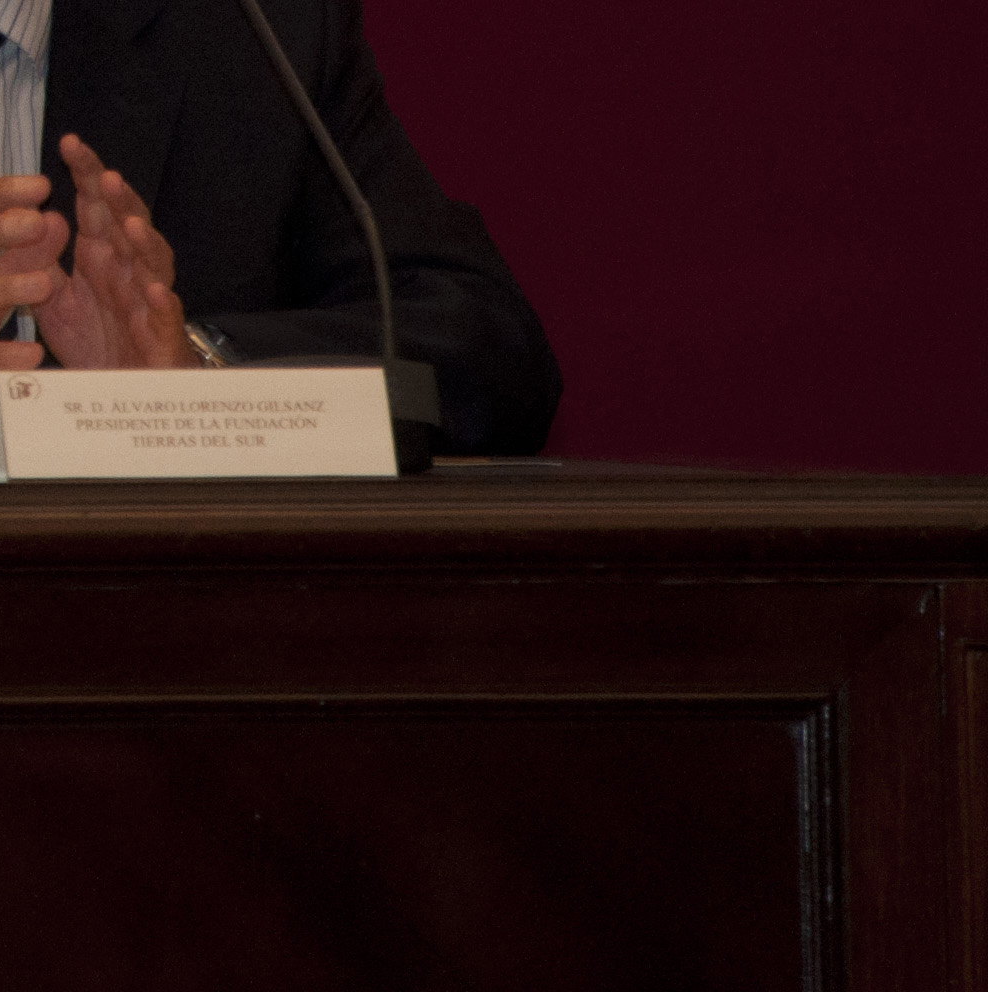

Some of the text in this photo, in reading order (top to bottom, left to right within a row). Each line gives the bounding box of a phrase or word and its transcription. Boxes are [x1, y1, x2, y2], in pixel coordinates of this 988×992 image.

[179, 401, 254, 413] LORENZO
[256, 401, 326, 413] GILSANZ
[75, 418, 171, 431] PRESIDENTE
[174, 418, 196, 430] DE
[199, 418, 221, 430] LA
[132, 435, 268, 448] TIERRAS DEL SUR
